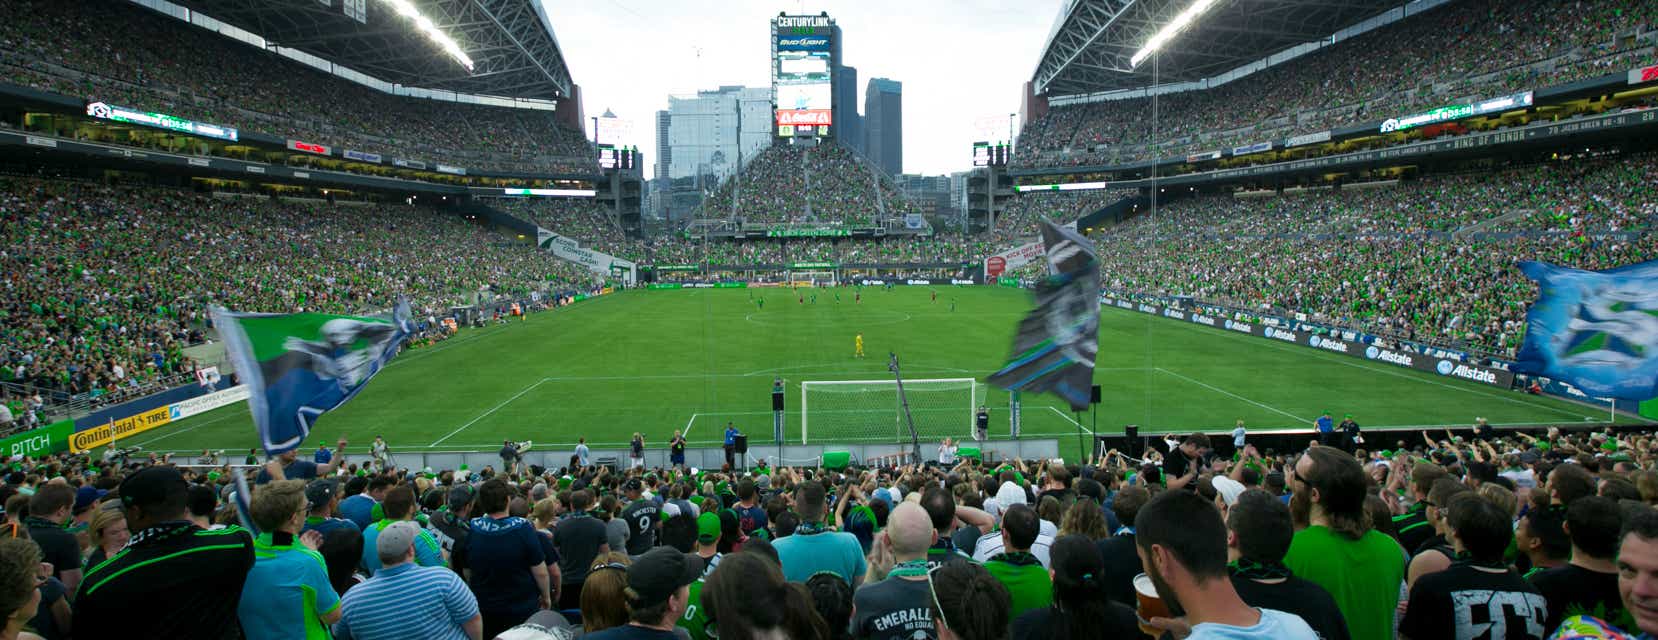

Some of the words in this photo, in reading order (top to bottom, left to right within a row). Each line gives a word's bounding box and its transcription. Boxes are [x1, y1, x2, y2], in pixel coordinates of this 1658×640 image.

[778, 16, 829, 27] CENTURYLINK
[1454, 136, 1474, 150] RING
[1478, 134, 1489, 146] OF
[1494, 128, 1525, 144] HONOR
[1273, 328, 1297, 342] Allstate
[1318, 337, 1349, 353] Allstate
[1377, 349, 1413, 366] Allstate
[1451, 363, 1497, 384] Allstate
[146, 409, 168, 425] TIRE
[11, 433, 50, 457] PITCH
[633, 506, 657, 518] WINCHESTER
[639, 515, 651, 535] 9
[904, 622, 914, 630] NO
